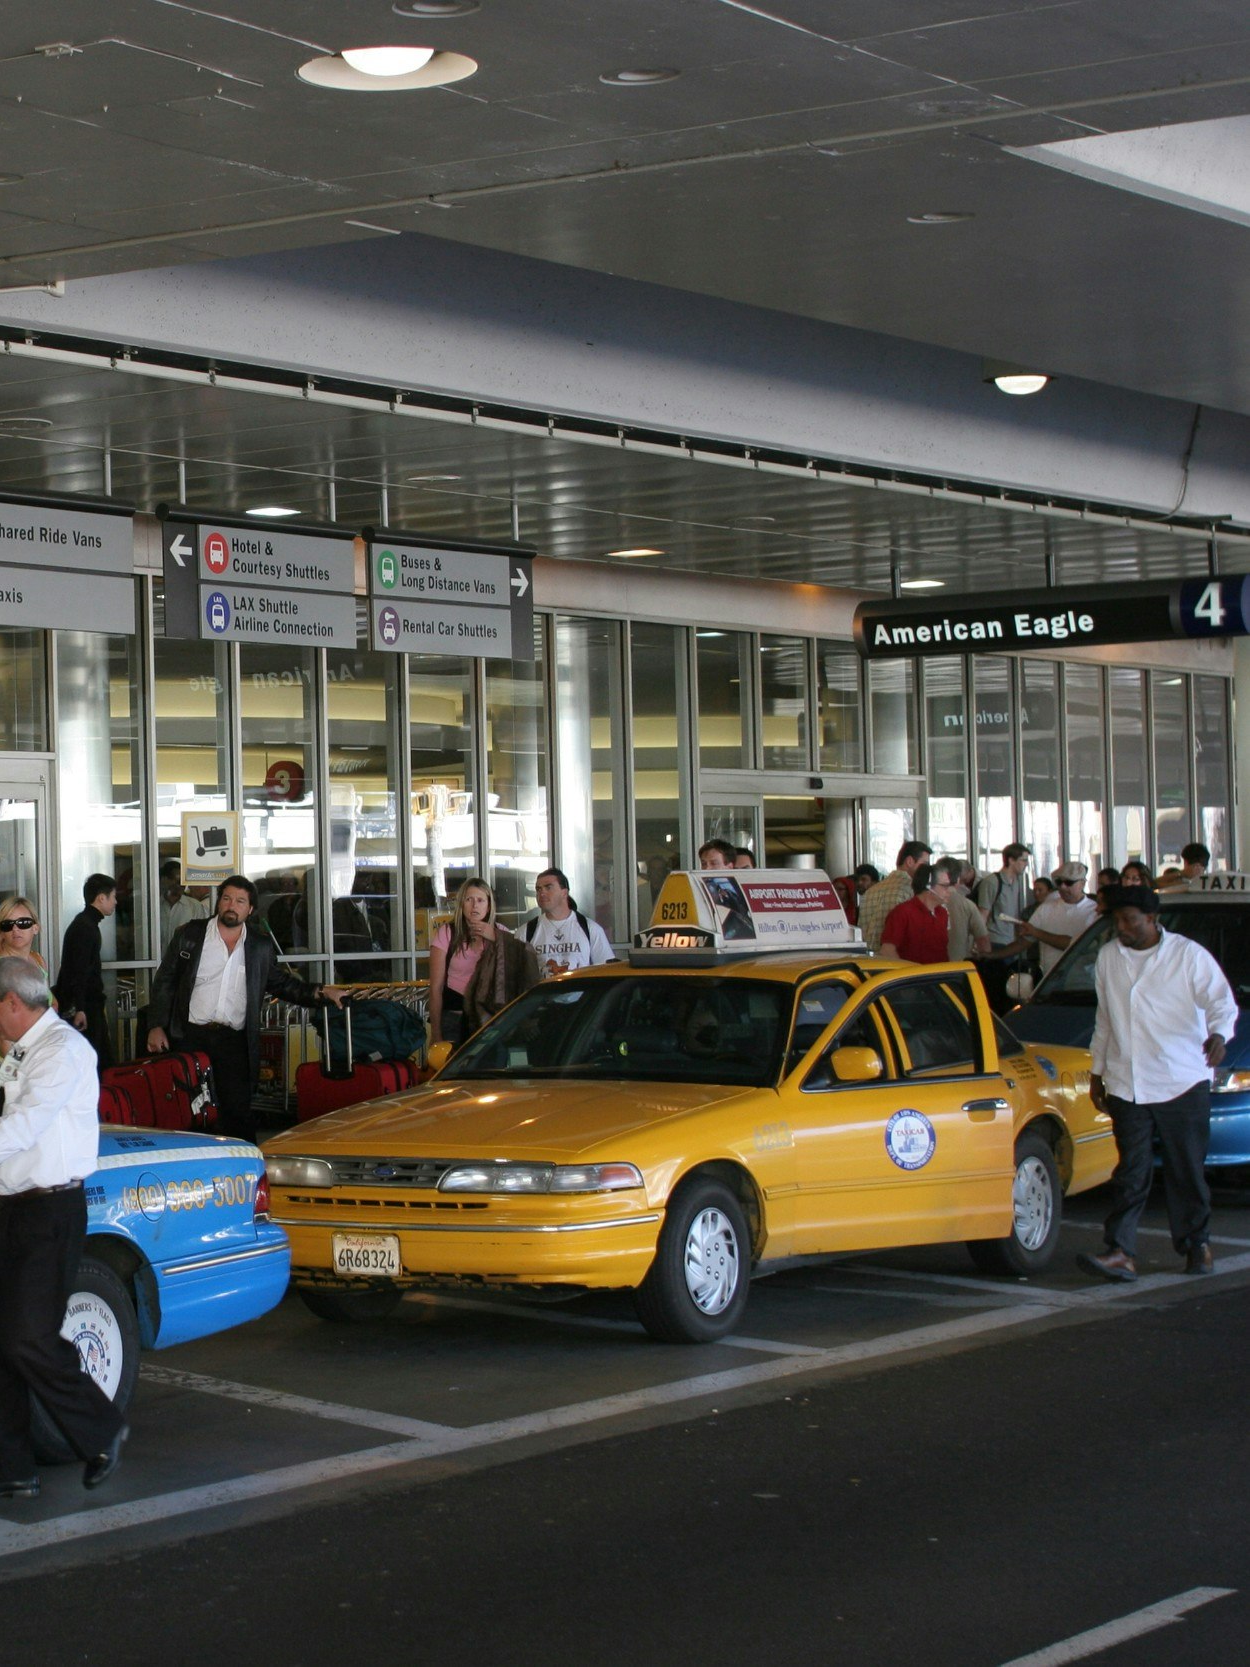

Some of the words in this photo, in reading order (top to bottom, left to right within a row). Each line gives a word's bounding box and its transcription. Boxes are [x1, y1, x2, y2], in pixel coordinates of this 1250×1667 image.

[40, 525, 67, 544] Ride
[73, 530, 102, 548] Vans
[232, 537, 261, 555] Hotel
[264, 542, 273, 556] &
[233, 559, 281, 578] Courtesy
[285, 564, 330, 581] Shuttles
[401, 554, 430, 571] Buses
[434, 558, 442, 572] &
[402, 576, 424, 591] Long
[428, 576, 469, 592] Distance
[473, 580, 496, 595] Vans
[233, 596, 254, 612] LAX
[258, 598, 298, 614] Shuttle
[1194, 582, 1226, 626] 4
[234, 616, 270, 633] Airline
[273, 619, 333, 637] Connection
[402, 619, 435, 635] Rental
[437, 622, 454, 636] Car
[458, 623, 498, 638] Shuttles
[874, 619, 1003, 646] American
[1014, 611, 1094, 640] Eagle
[274, 770, 291, 794] 3
[1200, 876, 1245, 890] TAXI
[749, 889, 777, 899] AIRPORT
[777, 889, 805, 899] PARKING
[805, 888, 818, 898] $10
[662, 902, 688, 920] 6213
[758, 923, 777, 932] Hilton
[821, 921, 843, 933] Airport
[536, 942, 581, 954] SINGHA
[639, 933, 708, 948] Yellow
[895, 1128, 925, 1137] TAXICAB
[347, 1237, 382, 1249] California
[338, 1248, 395, 1269] 6R68324
[68, 1303, 91, 1317] BANNERS
[99, 1308, 111, 1327] FLAGS
